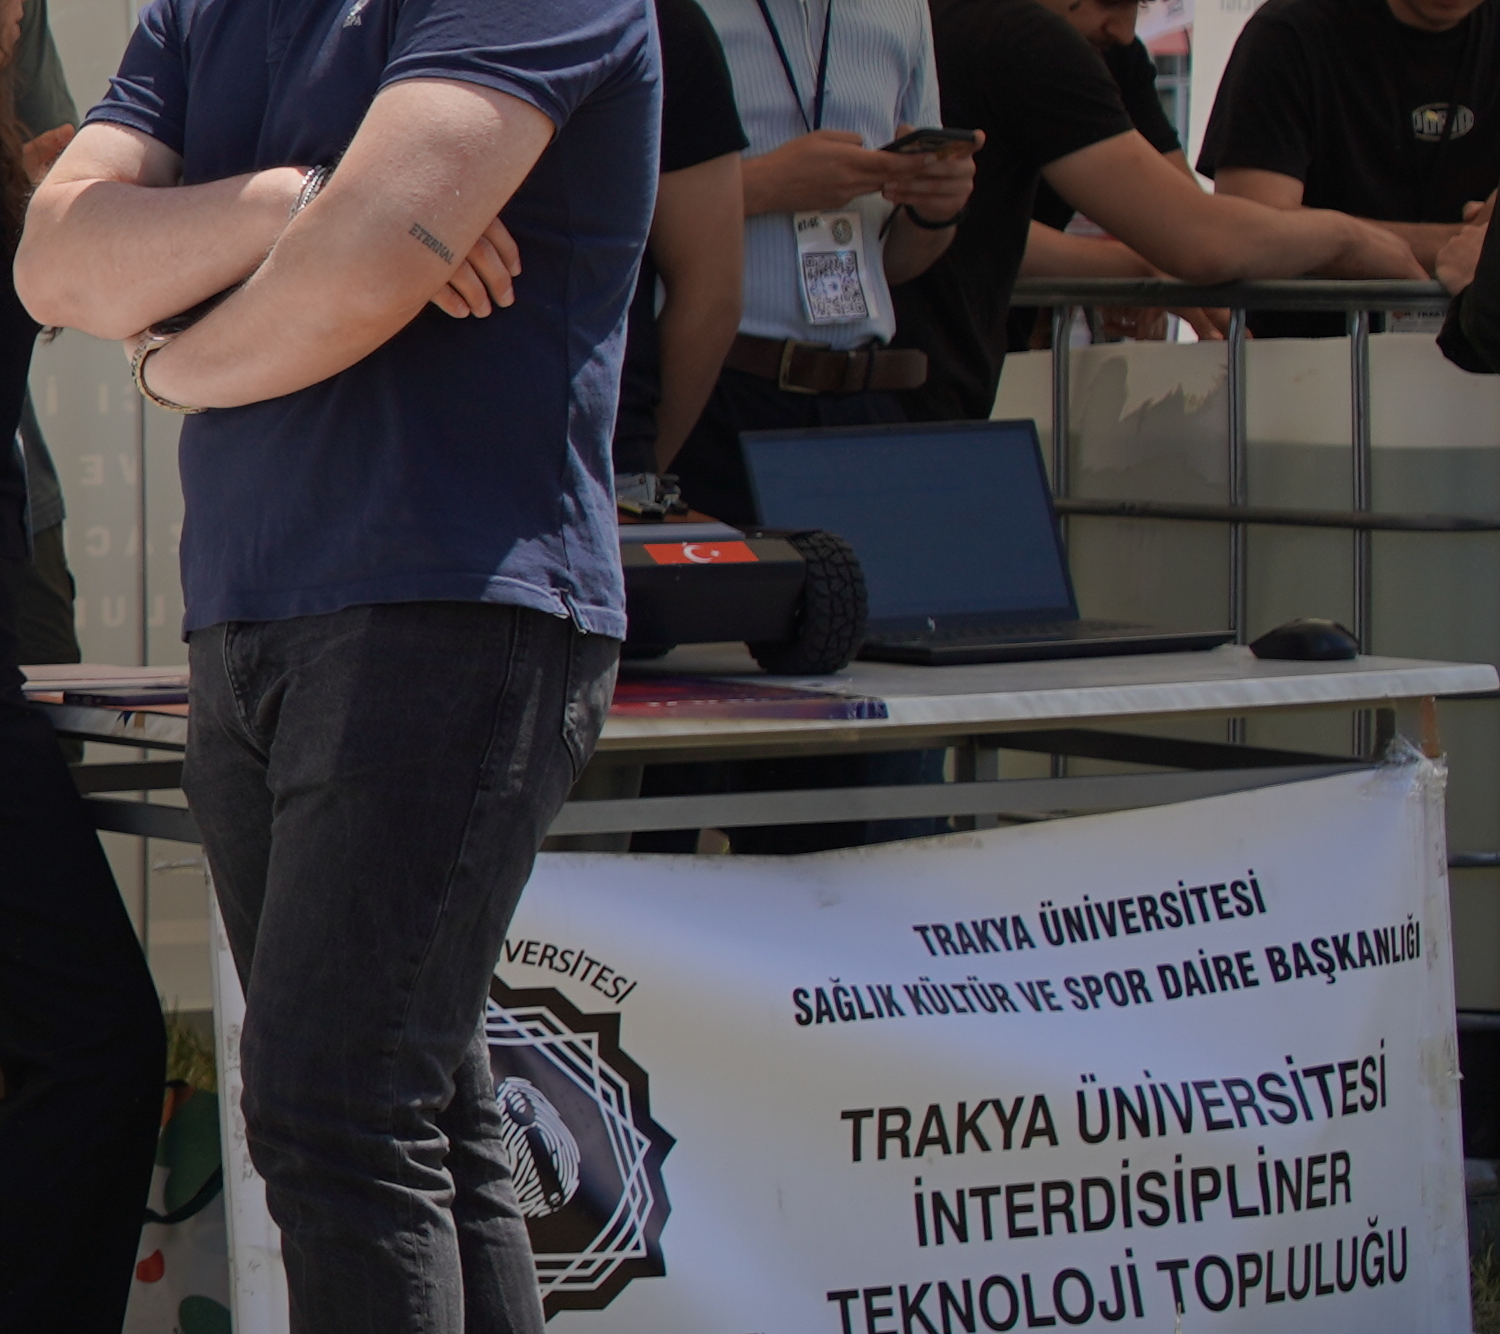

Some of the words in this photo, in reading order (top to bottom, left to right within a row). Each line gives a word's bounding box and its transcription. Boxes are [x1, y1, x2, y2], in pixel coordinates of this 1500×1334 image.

[408, 222, 455, 265] ETERNAL
[913, 915, 1037, 957] TRAKYA
[1040, 868, 1267, 950] ÜNİVERSİTESİ
[503, 937, 638, 1006] VERSİTESİ
[792, 975, 906, 1028] SAĞLIK
[908, 977, 1020, 1019] KÜLTÜR
[1021, 977, 1064, 1014] VE
[1063, 963, 1155, 1011] SPOR
[1157, 946, 1260, 1001] DAİRE
[1265, 912, 1422, 987] BAŞKANLIĞI
[840, 1092, 1060, 1164] TRAKYA
[1074, 1037, 1389, 1146] ÜNİVERSİTESİ
[912, 1147, 1353, 1248] İNTERDİSİPLİNER
[1156, 1215, 1410, 1312] TOPLULUĞU
